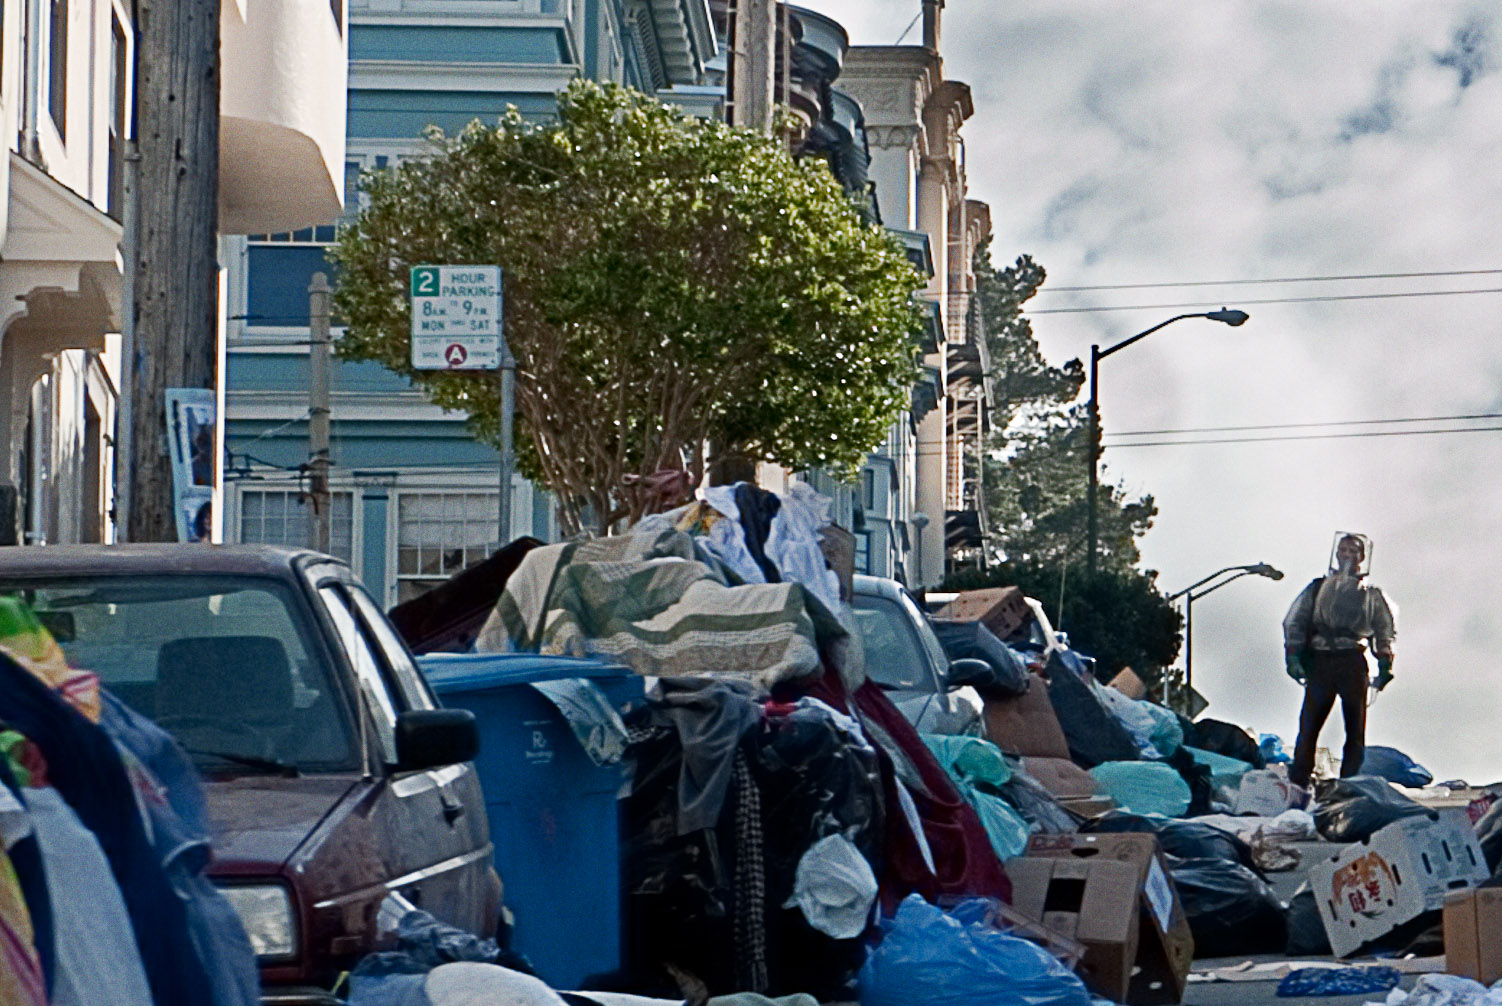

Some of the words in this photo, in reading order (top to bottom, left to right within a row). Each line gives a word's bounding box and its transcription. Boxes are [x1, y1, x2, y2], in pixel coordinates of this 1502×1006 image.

[418, 270, 434, 293] 2
[451, 273, 486, 284] HOUR
[442, 285, 495, 297] PARKING
[421, 320, 445, 331] MON
[470, 319, 490, 331] SAT
[448, 345, 464, 362] A
